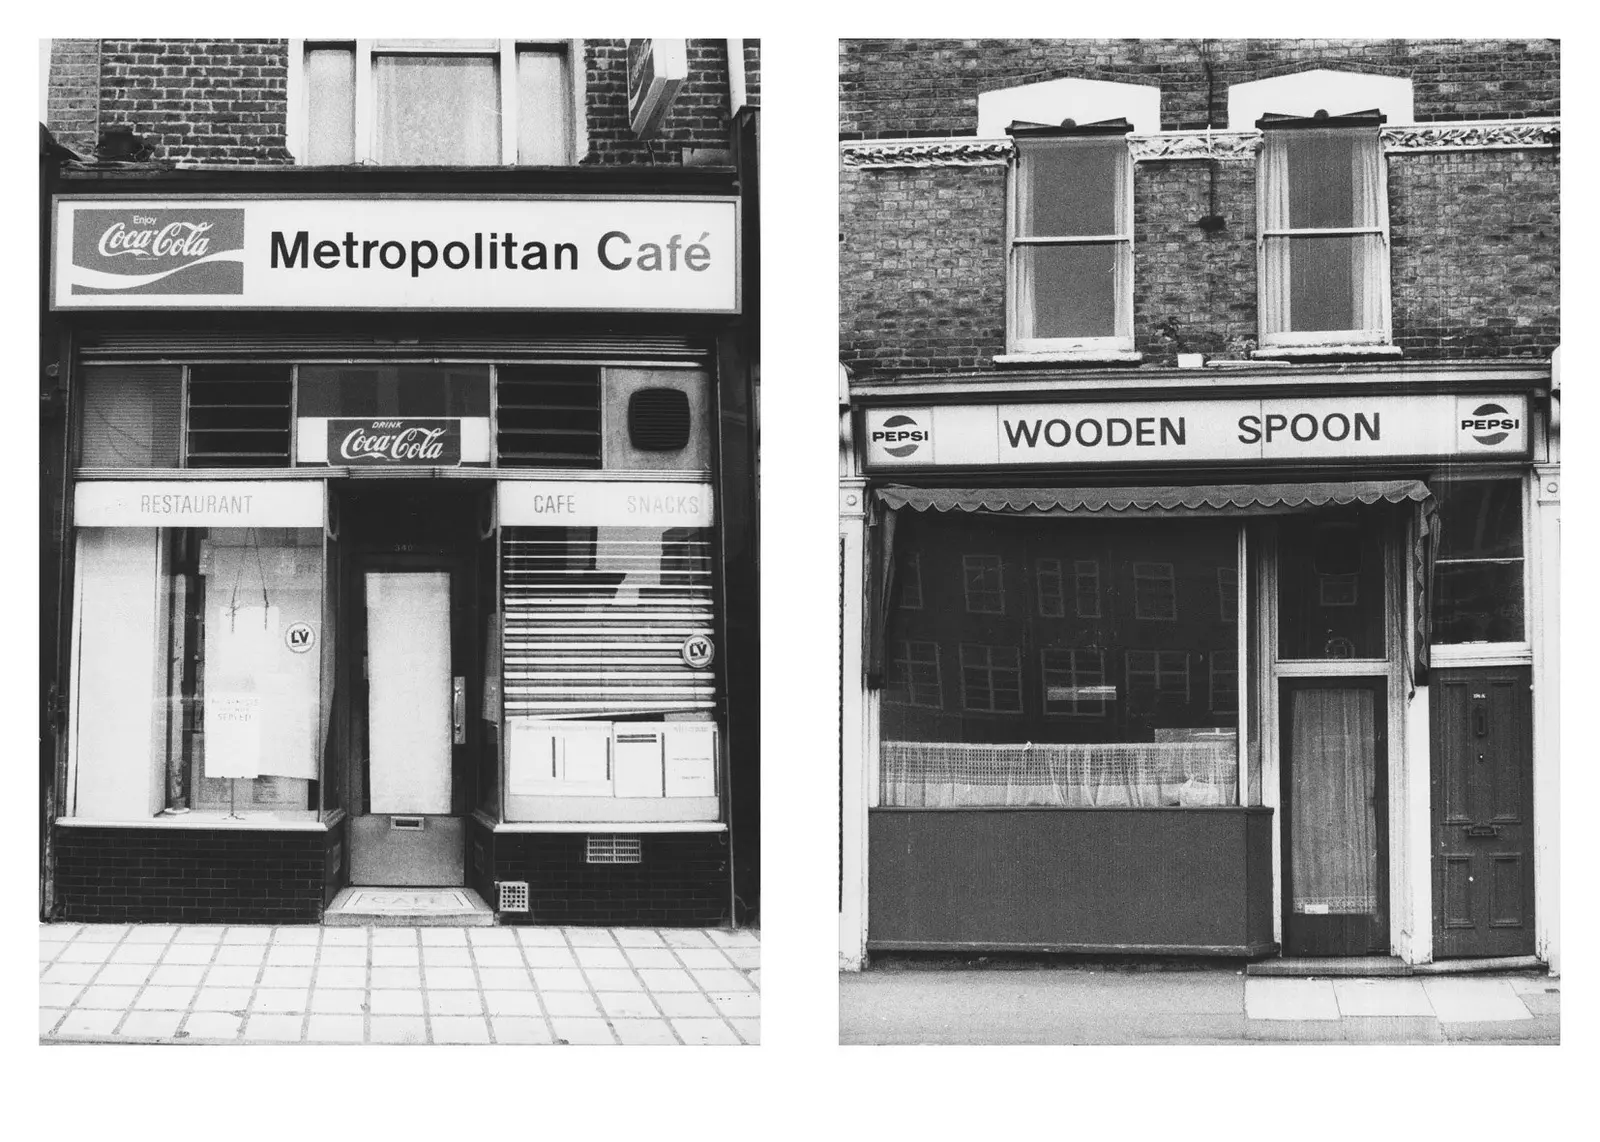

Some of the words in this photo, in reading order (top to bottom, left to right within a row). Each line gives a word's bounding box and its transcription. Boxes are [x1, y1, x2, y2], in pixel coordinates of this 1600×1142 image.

[133, 215, 157, 226] Enjoy
[98, 221, 215, 257] Coca-Cola
[270, 231, 579, 277] Metropolitan
[597, 230, 711, 272] Café
[371, 421, 404, 429] DRINK
[1003, 416, 1187, 448] WOODEN
[1237, 411, 1381, 445] SPOON
[1461, 419, 1520, 430] PEPSI
[340, 427, 447, 460] Coca-Cola
[872, 431, 929, 442] PEPSI
[140, 494, 253, 514] RESTAURANT
[533, 494, 576, 514] CAFE
[627, 494, 699, 514] SNACKS
[291, 631, 309, 643] LV
[690, 644, 707, 656] LV
